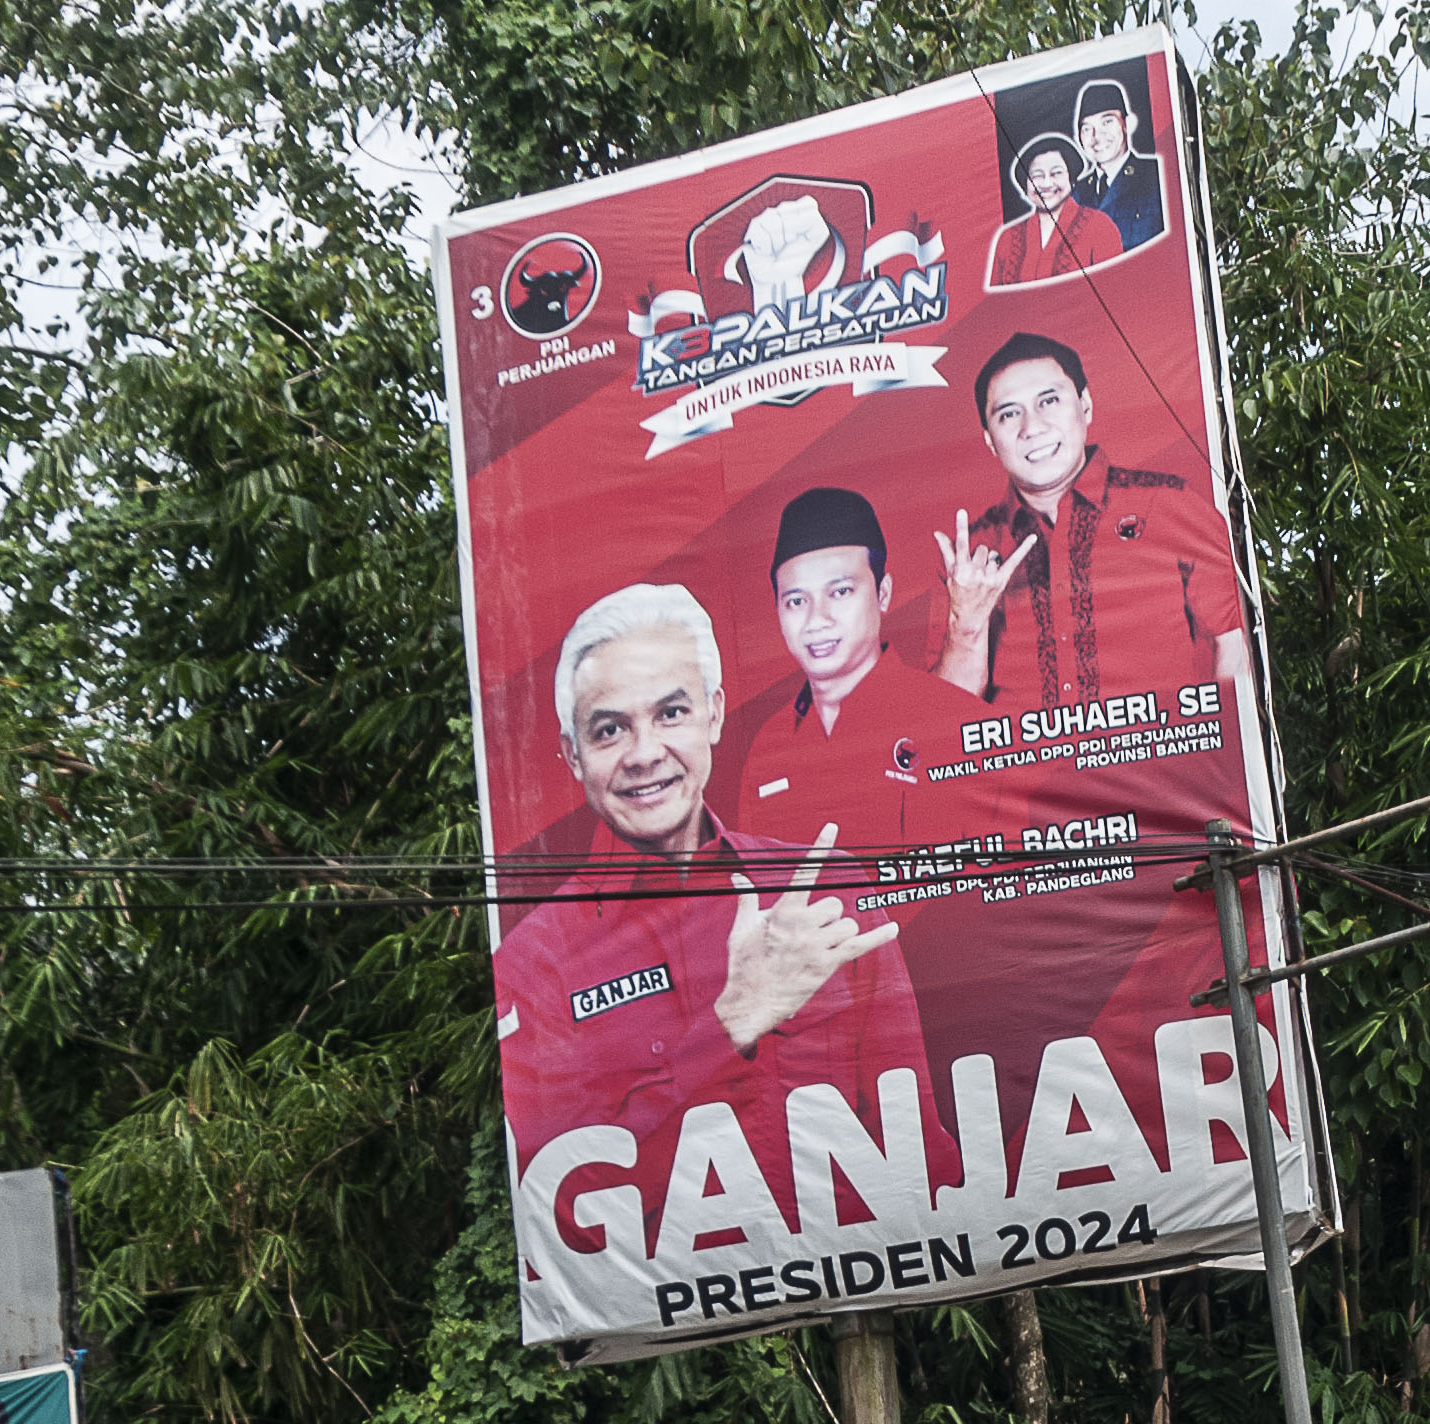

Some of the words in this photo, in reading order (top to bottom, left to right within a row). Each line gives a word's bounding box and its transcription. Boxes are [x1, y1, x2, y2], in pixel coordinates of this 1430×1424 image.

[471, 286, 494, 320] 3
[497, 340, 616, 388] PERJUANGAN
[539, 336, 570, 356] PDI
[643, 343, 758, 395] TANGAN
[763, 301, 943, 357] PERSATUAN
[684, 383, 744, 421] UNTUK
[747, 362, 845, 397] INDONESIA
[851, 353, 896, 374] RAYA
[962, 720, 1012, 753] ERI
[1020, 693, 1169, 743] SUHAERI,
[1179, 684, 1221, 717] SE
[928, 760, 979, 782] WAKIL
[982, 751, 1036, 772] KETUA
[1041, 743, 1075, 762] DPD
[1078, 737, 1106, 755] PDI
[1110, 720, 1221, 751] PERJUANGAN
[1076, 747, 1151, 770] PROVINSI
[1156, 735, 1223, 760] BANTEN
[856, 881, 952, 912] SEKRETARIS
[983, 885, 1021, 904] KAB.
[1026, 865, 1135, 895] PANDEGLANG
[578, 968, 667, 1014] GANJAR
[518, 1012, 1293, 1264] GANJAR
[655, 1233, 975, 1327] PRESIDEN
[998, 1203, 1157, 1271] 2024
